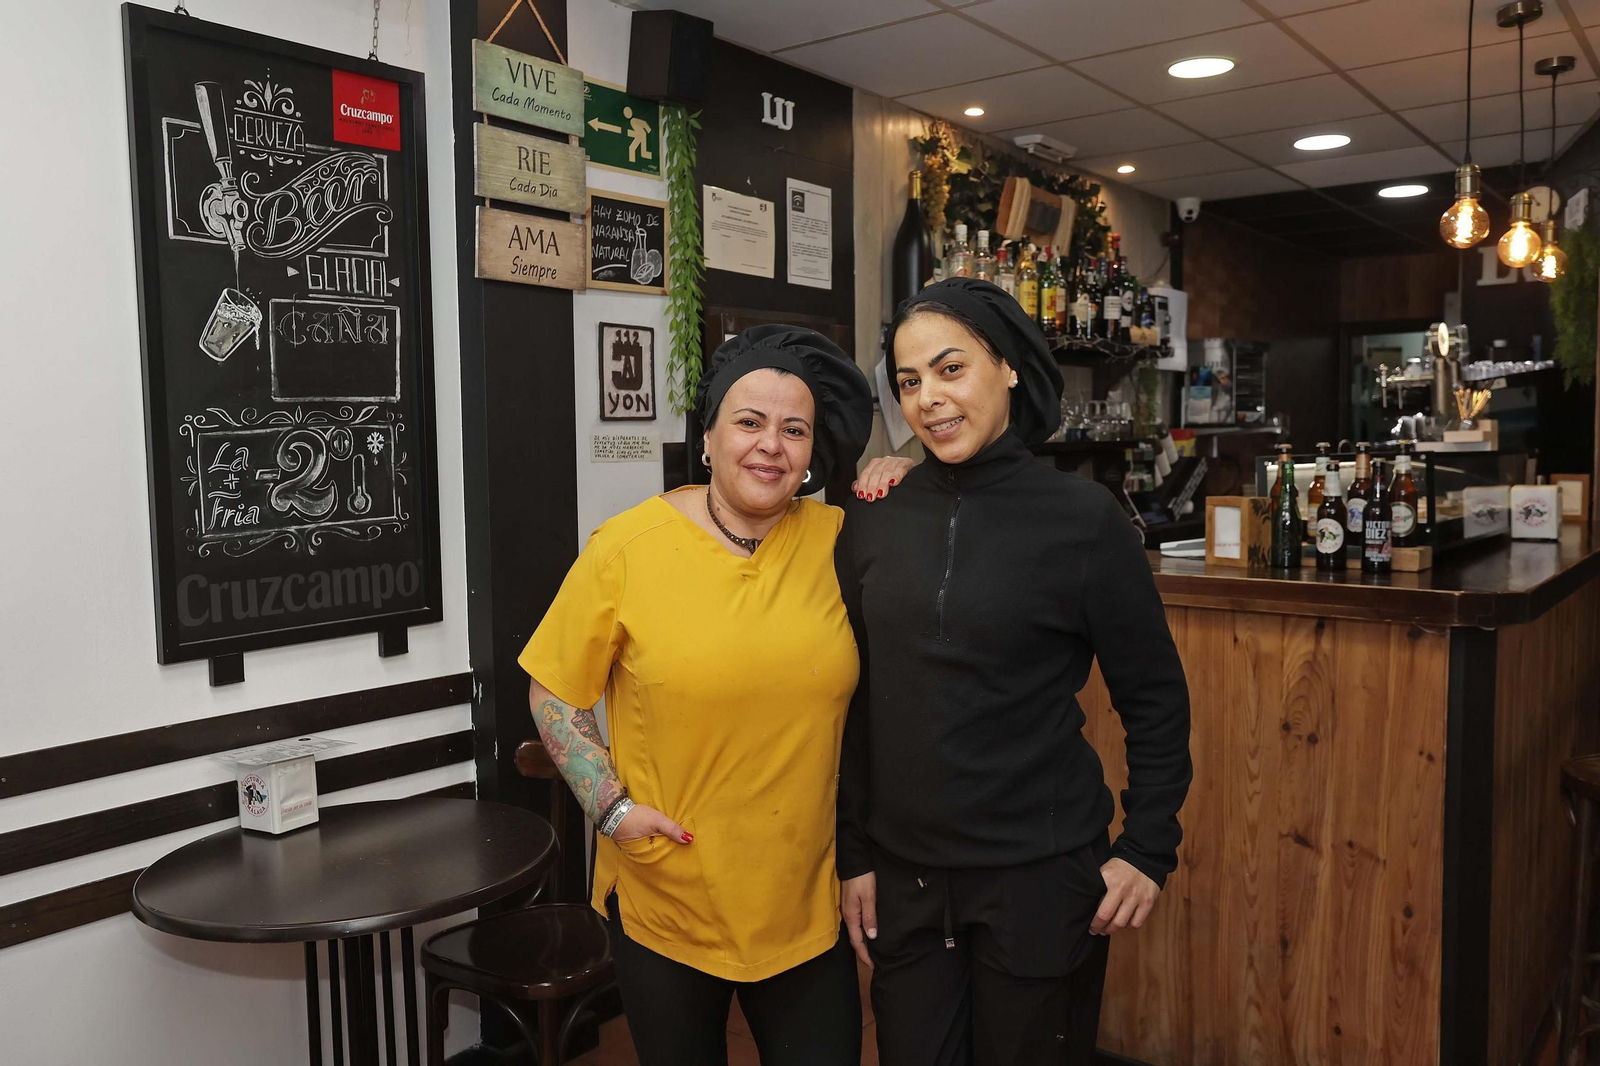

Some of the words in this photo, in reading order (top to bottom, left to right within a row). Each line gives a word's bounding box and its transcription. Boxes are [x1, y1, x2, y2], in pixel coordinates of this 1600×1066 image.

[505, 57, 557, 95] VIVE
[340, 103, 394, 125] Cruzcampo
[491, 86, 520, 107] Cada
[523, 96, 572, 121] Momento
[761, 92, 795, 131] LU
[233, 114, 305, 152] CERVEZA
[516, 145, 551, 176] RIE
[509, 176, 537, 195] Cada
[539, 183, 558, 198] Dia
[252, 167, 378, 250] Beer
[593, 204, 612, 221] HAY
[616, 209, 641, 227] ZUMO
[646, 213, 660, 227] DE
[507, 224, 561, 257] AMA
[592, 224, 635, 243] NARANJA
[510, 255, 557, 283] Siempre
[591, 245, 631, 263] NATURAL
[306, 254, 393, 297] GLACIAL
[207, 441, 249, 474] La
[176, 560, 419, 628] Cruzcampo
[242, 776, 266, 790] VICTORIA
